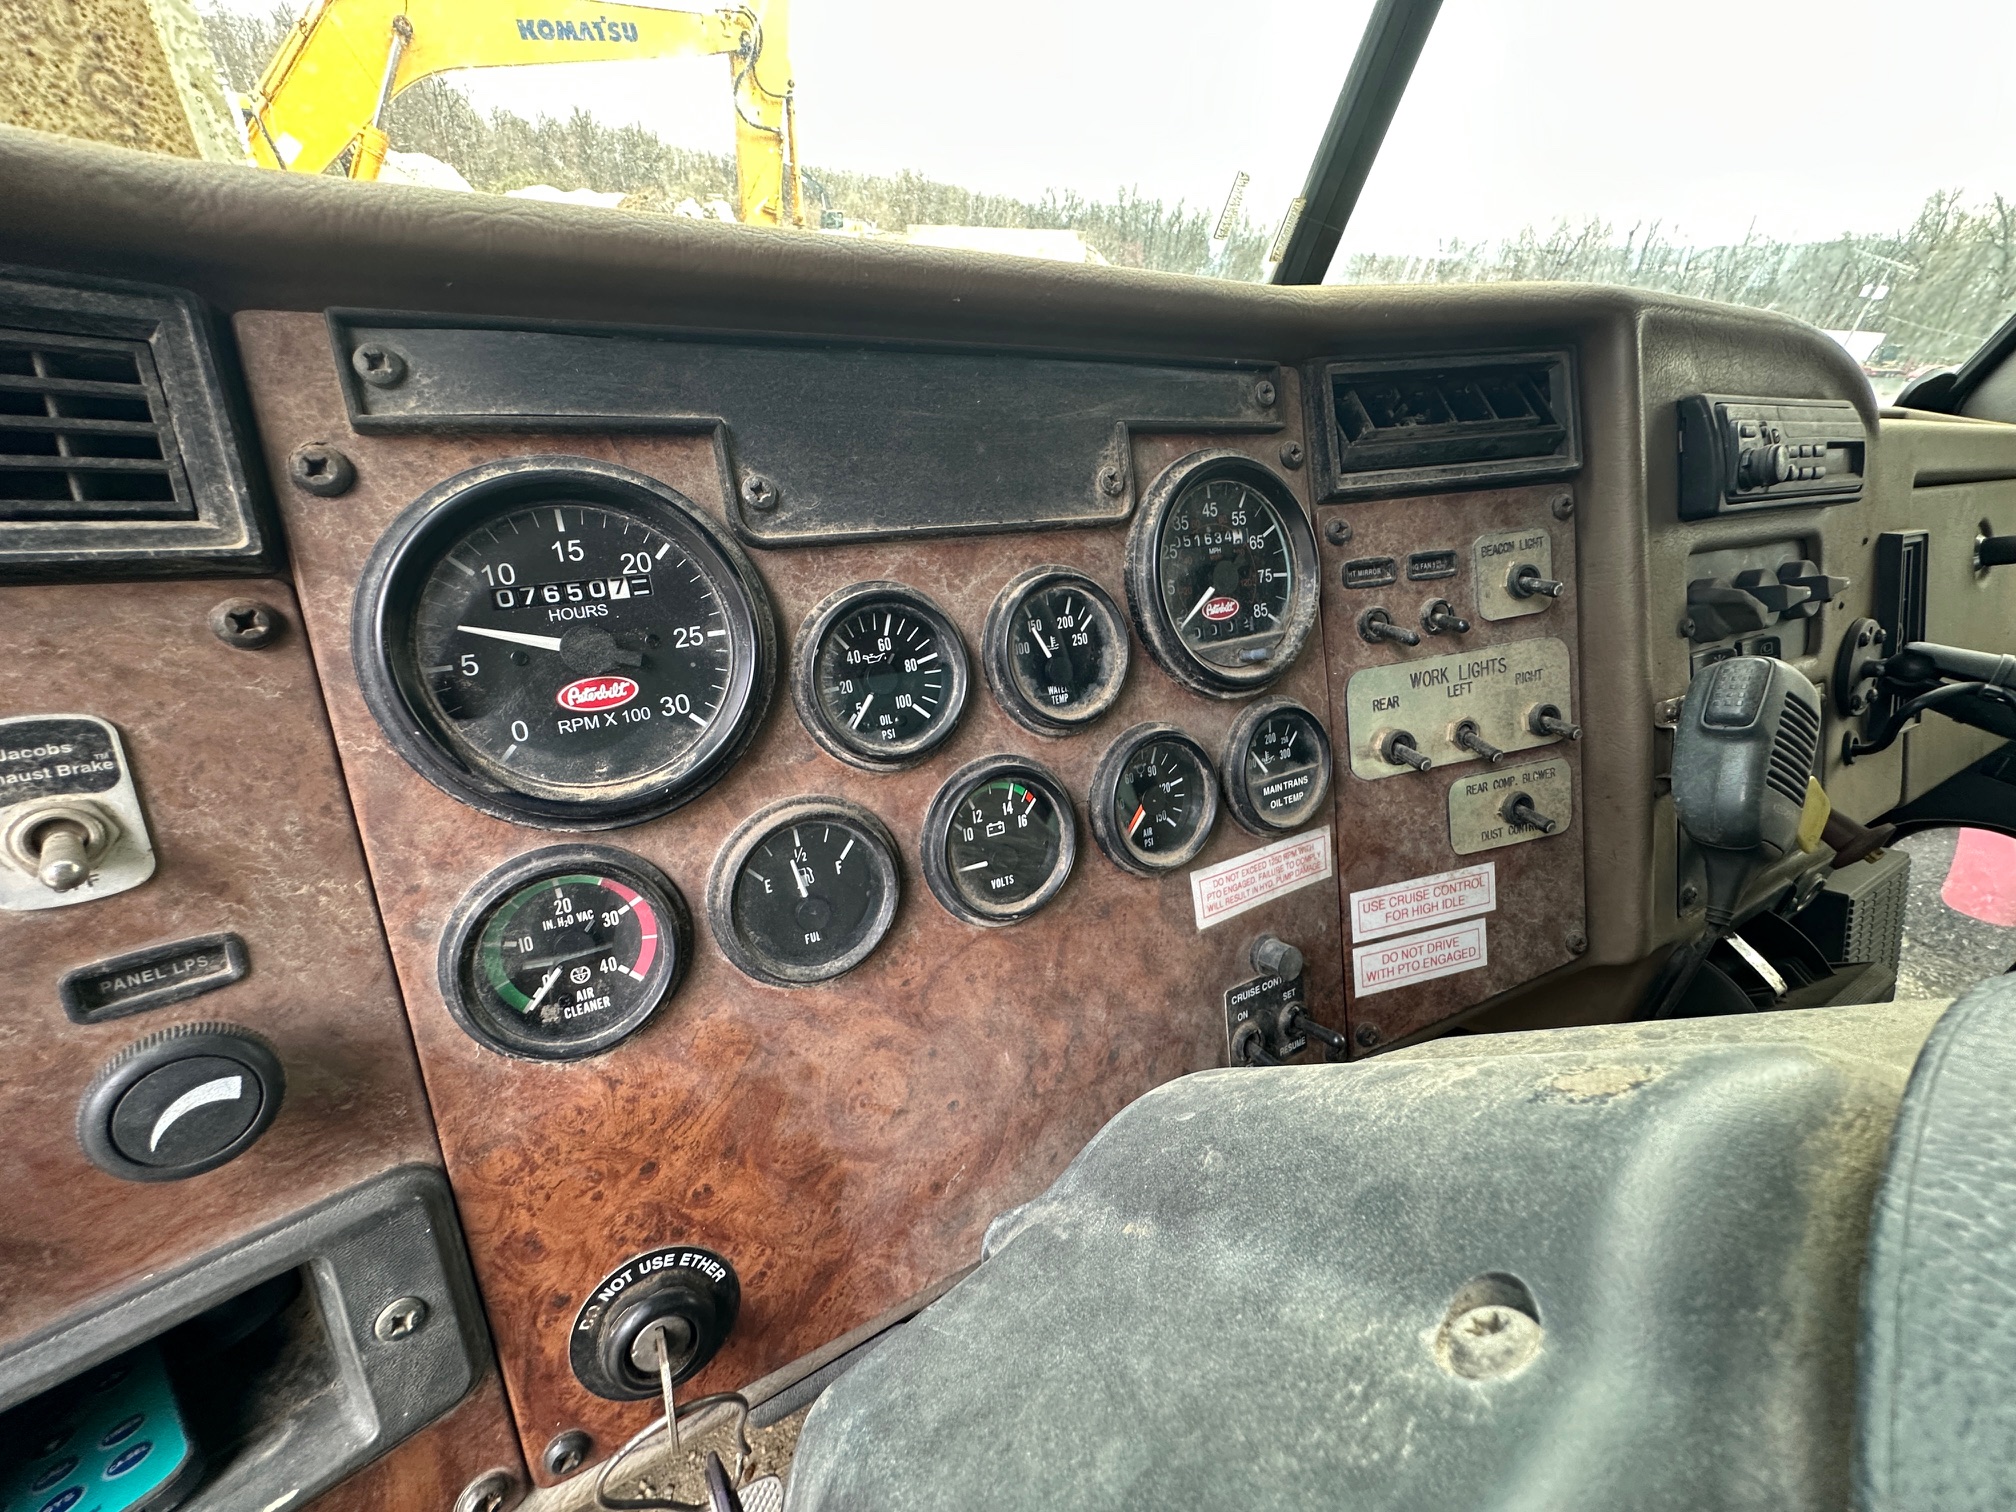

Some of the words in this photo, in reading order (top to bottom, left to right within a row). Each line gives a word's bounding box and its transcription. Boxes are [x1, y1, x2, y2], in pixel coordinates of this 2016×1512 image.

[516, 16, 639, 42] KOMATSU
[1201, 502, 1218, 518] 45
[1231, 510, 1247, 526] 55
[1173, 515, 1189, 531] 35
[1249, 534, 1264, 550] 65
[1481, 540, 1515, 558] BEACON
[1519, 536, 1544, 551] LIGHT
[551, 540, 585, 563] 15
[1162, 544, 1178, 560] 25
[1208, 547, 1222, 555] MPH
[620, 551, 653, 575] 20
[481, 562, 516, 587] 10
[1257, 568, 1273, 583] 75
[1357, 567, 1381, 577] MIRROR
[496, 576, 631, 608] 076507
[548, 604, 609, 622] HOURS
[1253, 602, 1268, 618] 85
[1056, 615, 1074, 630] 200
[673, 626, 704, 649] 25
[877, 636, 892, 652] 60
[1071, 632, 1088, 647] 250
[461, 654, 479, 676] 5
[846, 649, 861, 665] 40
[904, 658, 918, 673] 80
[1409, 666, 1450, 688] WORK
[1458, 657, 1507, 681] LIGHTS
[1514, 668, 1544, 685] RIGHT
[567, 681, 630, 707] Peterbilt
[839, 679, 853, 695] 20
[1446, 681, 1473, 698] LEFT
[659, 693, 690, 717] 30
[895, 693, 913, 710] 100
[1051, 693, 1069, 705] TEMP
[1372, 695, 1400, 713] REAR
[557, 714, 600, 735] RPM
[603, 712, 618, 727] X
[621, 706, 651, 723] 100
[879, 713, 894, 726] OIL
[511, 720, 528, 742] 0
[881, 728, 896, 740] PSI
[1264, 732, 1277, 745] 200
[1279, 747, 1291, 760] 300
[56, 760, 114, 777] Brake
[1147, 764, 1157, 778] 90
[1263, 783, 1283, 796] MAIN
[1283, 775, 1309, 789] TRANS
[1466, 781, 1488, 796] REAR
[1492, 775, 1518, 790] COMP.
[1002, 800, 1014, 816] 14
[1270, 798, 1283, 809] OIL
[1283, 791, 1304, 804] TEMP
[972, 809, 983, 824] 12
[1017, 814, 1028, 828] 16
[962, 827, 974, 842] 10
[1143, 826, 1153, 838] AIR
[1481, 826, 1504, 841] DUST
[1144, 837, 1154, 848] PSI
[793, 846, 808, 863] 1/2
[834, 859, 842, 875] F
[1212, 878, 1224, 889] DO
[1225, 871, 1240, 884] NOT
[1241, 862, 1267, 877] EXCEED
[1268, 855, 1283, 867] 1250
[990, 874, 1015, 890] VOLTS
[1206, 889, 1222, 902] PTO
[1258, 865, 1284, 881] FAILURE
[1285, 860, 1295, 870] TO
[1295, 851, 1321, 866] COMPLY
[764, 878, 773, 894] E
[1206, 899, 1224, 913] WILL
[1225, 888, 1250, 906] RESULT
[1251, 884, 1259, 895] IN
[1275, 870, 1294, 885] PUMP
[1362, 901, 1386, 914] USE
[1388, 888, 1430, 908] CRUISE
[1433, 875, 1485, 898] CONTROL
[553, 897, 572, 916] 20
[1385, 908, 1409, 923] FOR
[1411, 901, 1439, 917] HIGH
[1441, 894, 1466, 910] IDLE
[542, 920, 557, 932] IN.
[575, 909, 595, 923] VAC
[601, 910, 620, 928] 30
[518, 936, 534, 953] 10
[804, 930, 821, 945] FUL
[1381, 951, 1399, 965] DO
[1401, 944, 1425, 960] NOT
[1427, 936, 1460, 954] DRIVE
[599, 956, 618, 974] 40
[1366, 966, 1395, 982] WITH
[1397, 960, 1421, 975] PTO
[1423, 946, 1477, 969] ENGAGED
[100, 968, 167, 995] PANEL
[172, 955, 209, 975] LPS
[576, 986, 595, 1002] AIR
[1231, 985, 1260, 1005] CRUISE
[1282, 987, 1296, 1001] SET
[563, 995, 611, 1020] CLEANER
[1237, 1009, 1249, 1022] ON
[1279, 1036, 1306, 1056] RESUME
[598, 1268, 633, 1302] NOT
[638, 1253, 676, 1275] USE
[678, 1252, 726, 1283] ETHER
